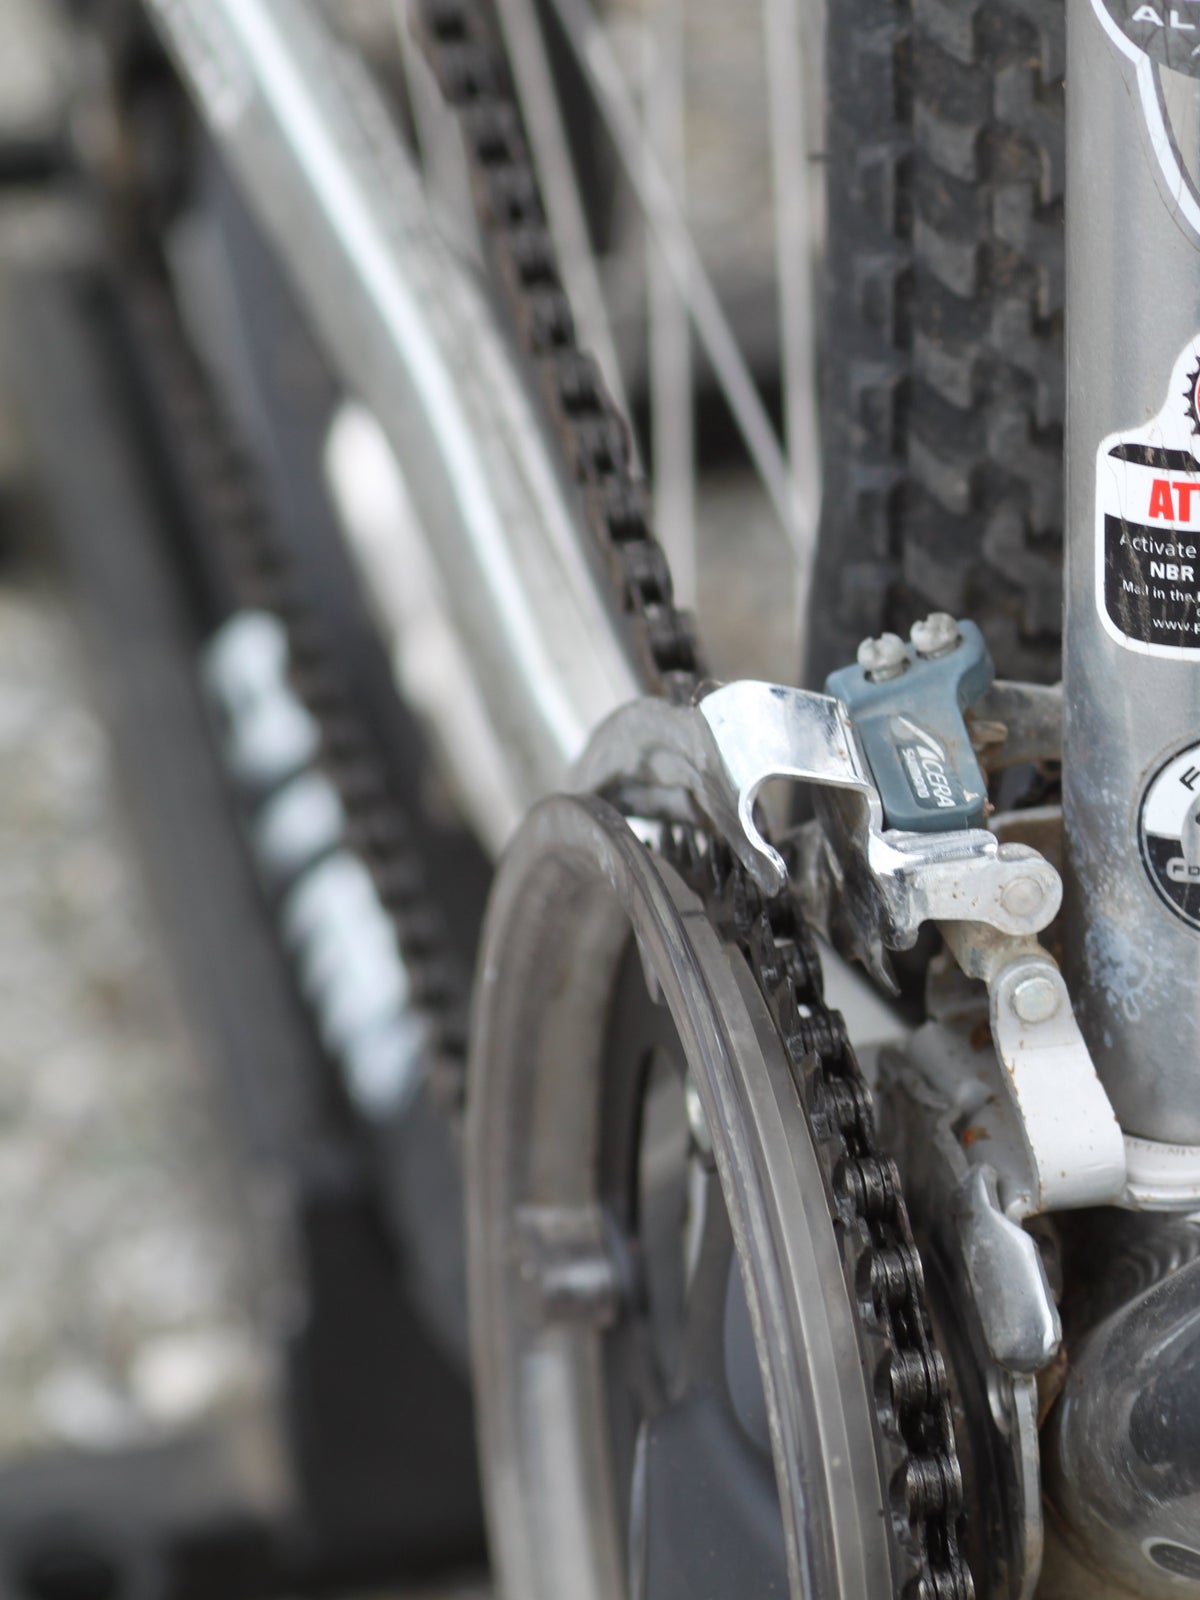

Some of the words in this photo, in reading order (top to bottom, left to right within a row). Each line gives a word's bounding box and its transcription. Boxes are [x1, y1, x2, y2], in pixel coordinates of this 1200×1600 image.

[1119, 534, 1197, 559] Activate
[1150, 561, 1195, 583] NBR
[1153, 586, 1166, 600] in
[1169, 589, 1195, 604] the
